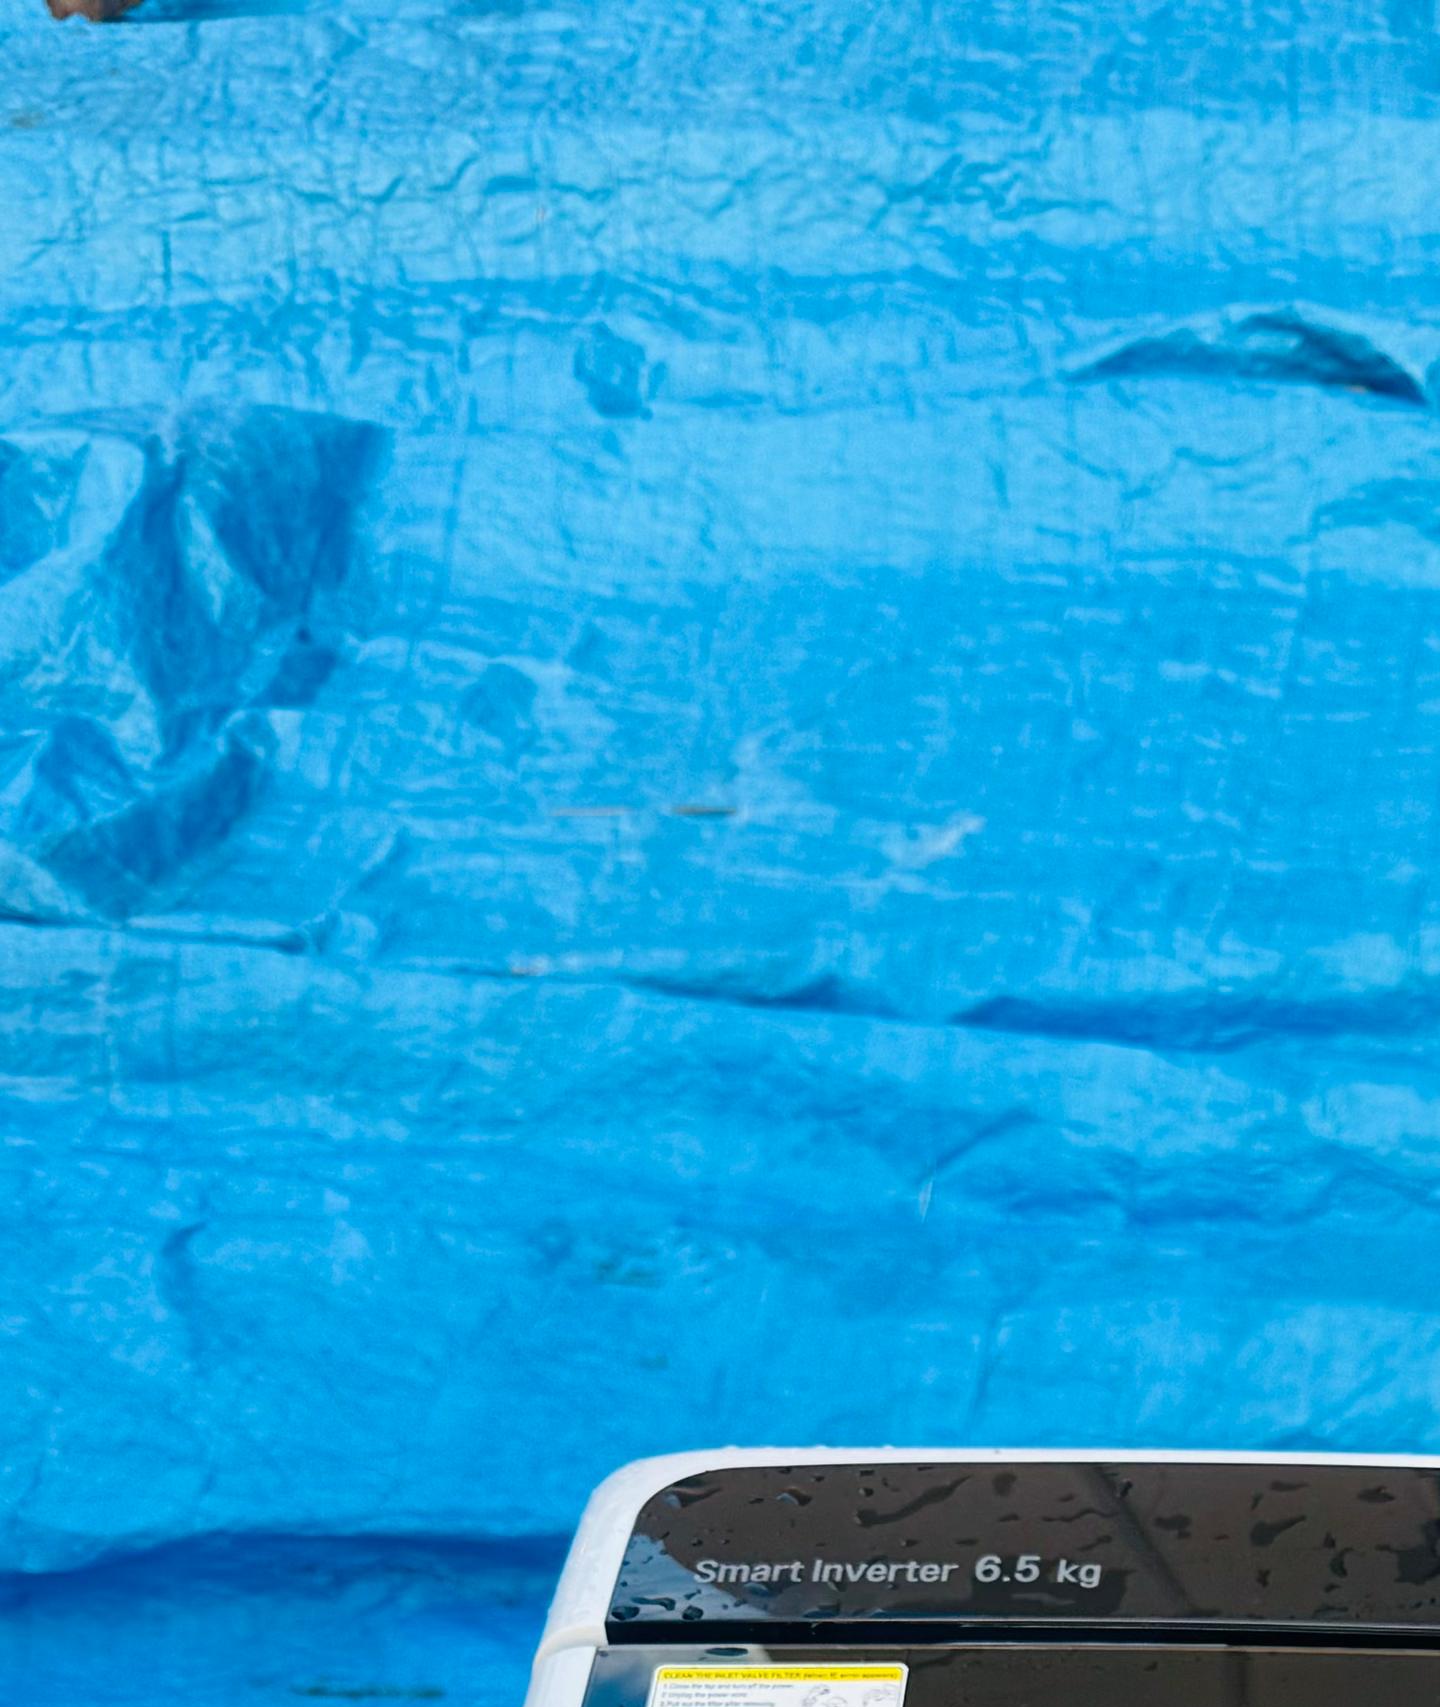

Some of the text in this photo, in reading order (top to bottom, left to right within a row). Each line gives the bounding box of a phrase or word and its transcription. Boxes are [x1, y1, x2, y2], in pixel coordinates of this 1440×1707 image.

[694, 1555, 1102, 1588] Smart Inverter 6.5 kg
